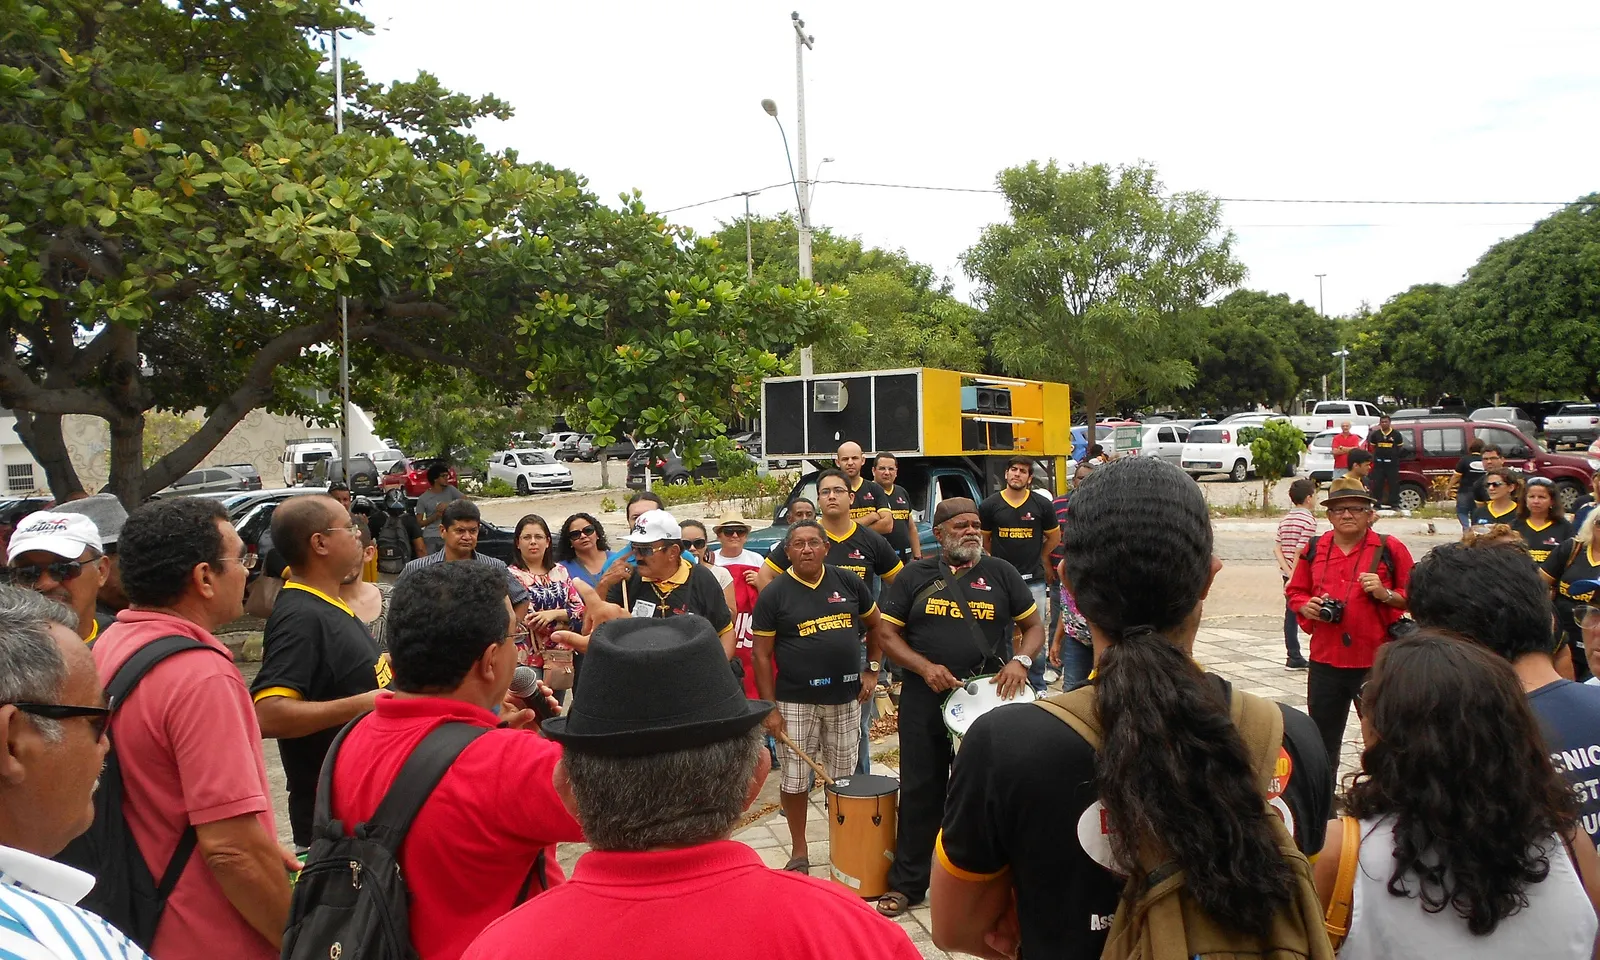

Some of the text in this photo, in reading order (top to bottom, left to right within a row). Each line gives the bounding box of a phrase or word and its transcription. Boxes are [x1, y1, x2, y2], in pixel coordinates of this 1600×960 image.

[925, 604, 995, 620] EM GEVE
[799, 619, 853, 637] EM GREVE
